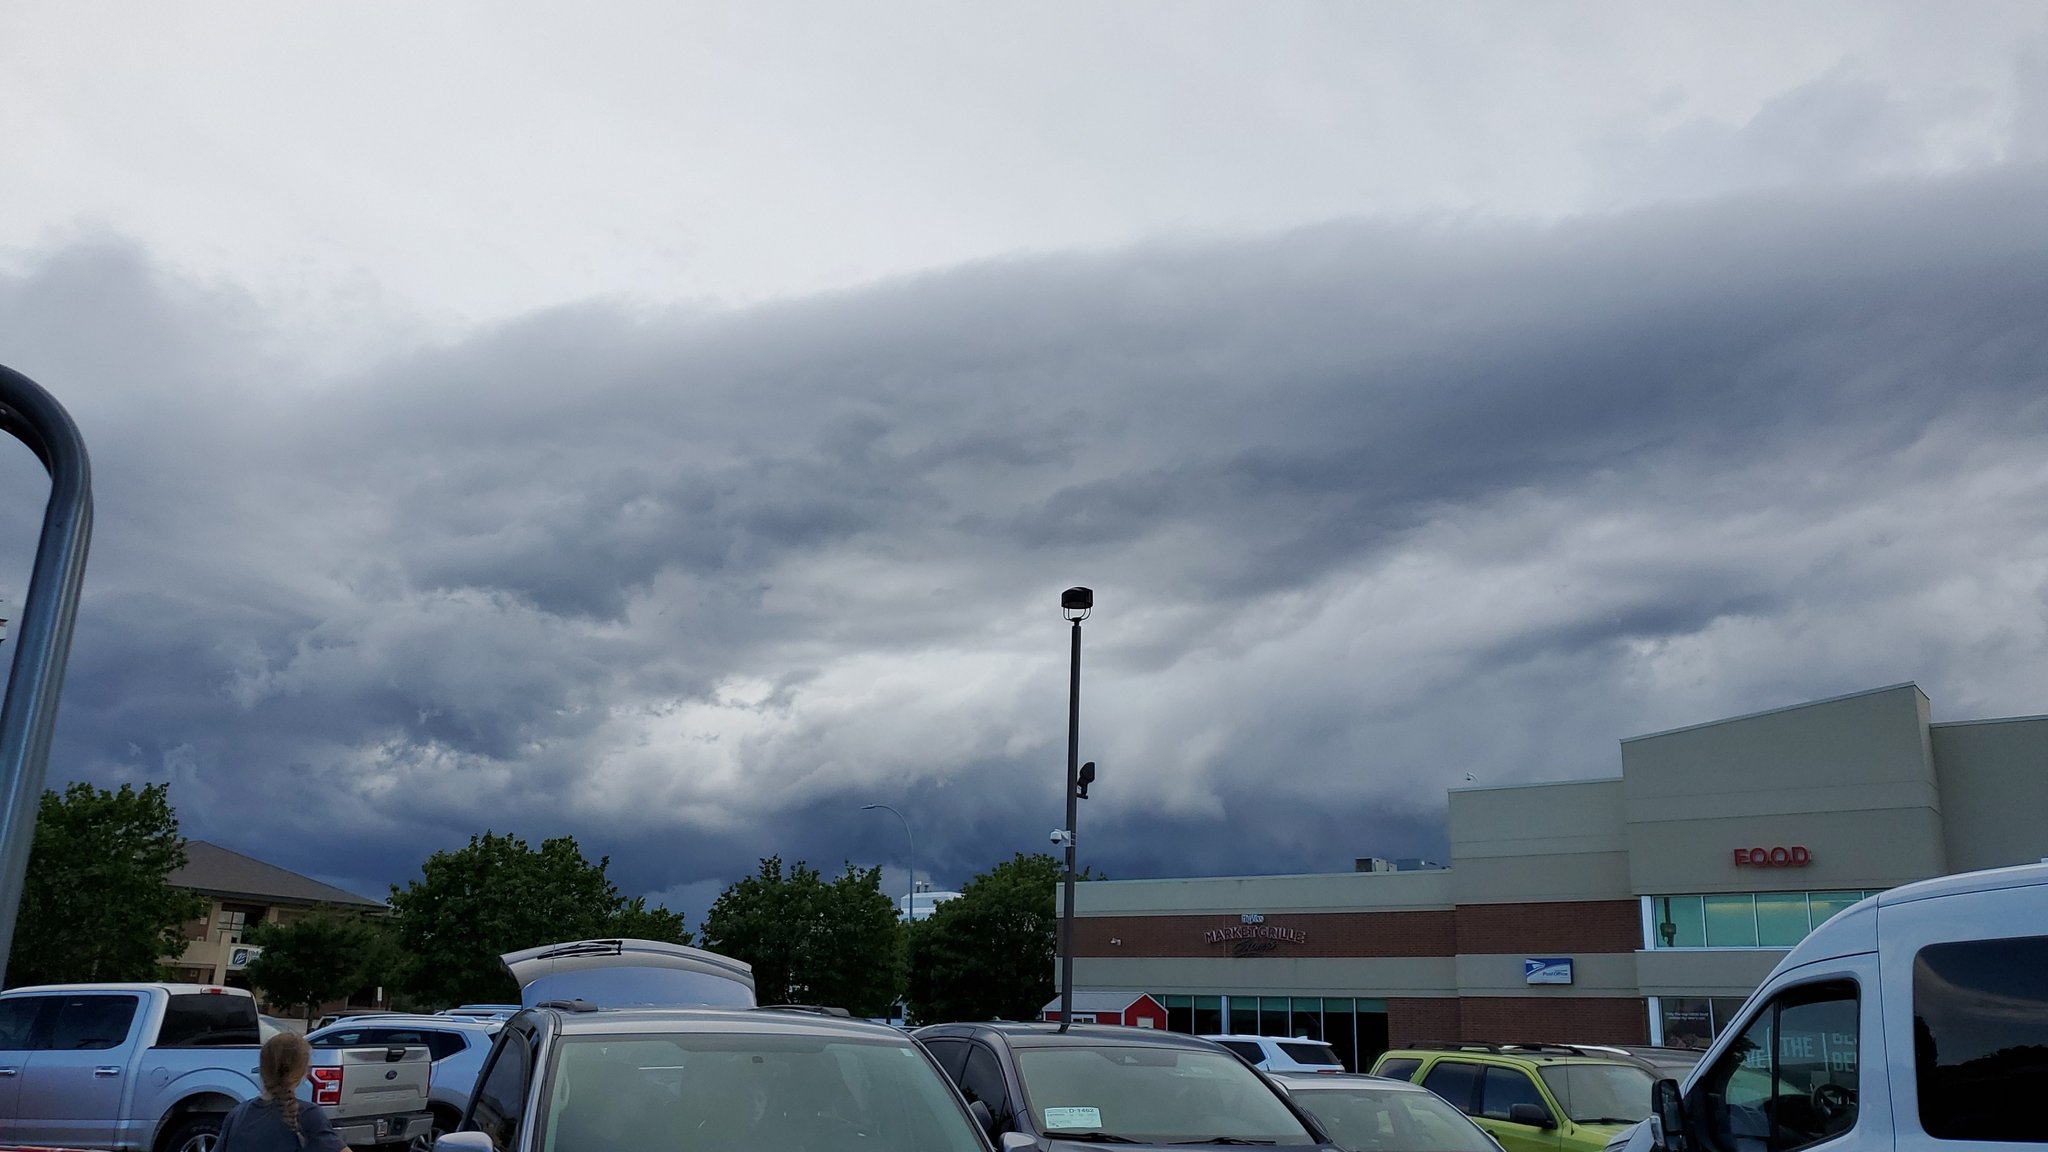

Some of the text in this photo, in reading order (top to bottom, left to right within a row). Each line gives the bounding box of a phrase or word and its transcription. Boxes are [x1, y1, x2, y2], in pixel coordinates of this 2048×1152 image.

[1733, 846, 1811, 867] FOOD
[1205, 926, 1306, 944] MARKET GRILLE
